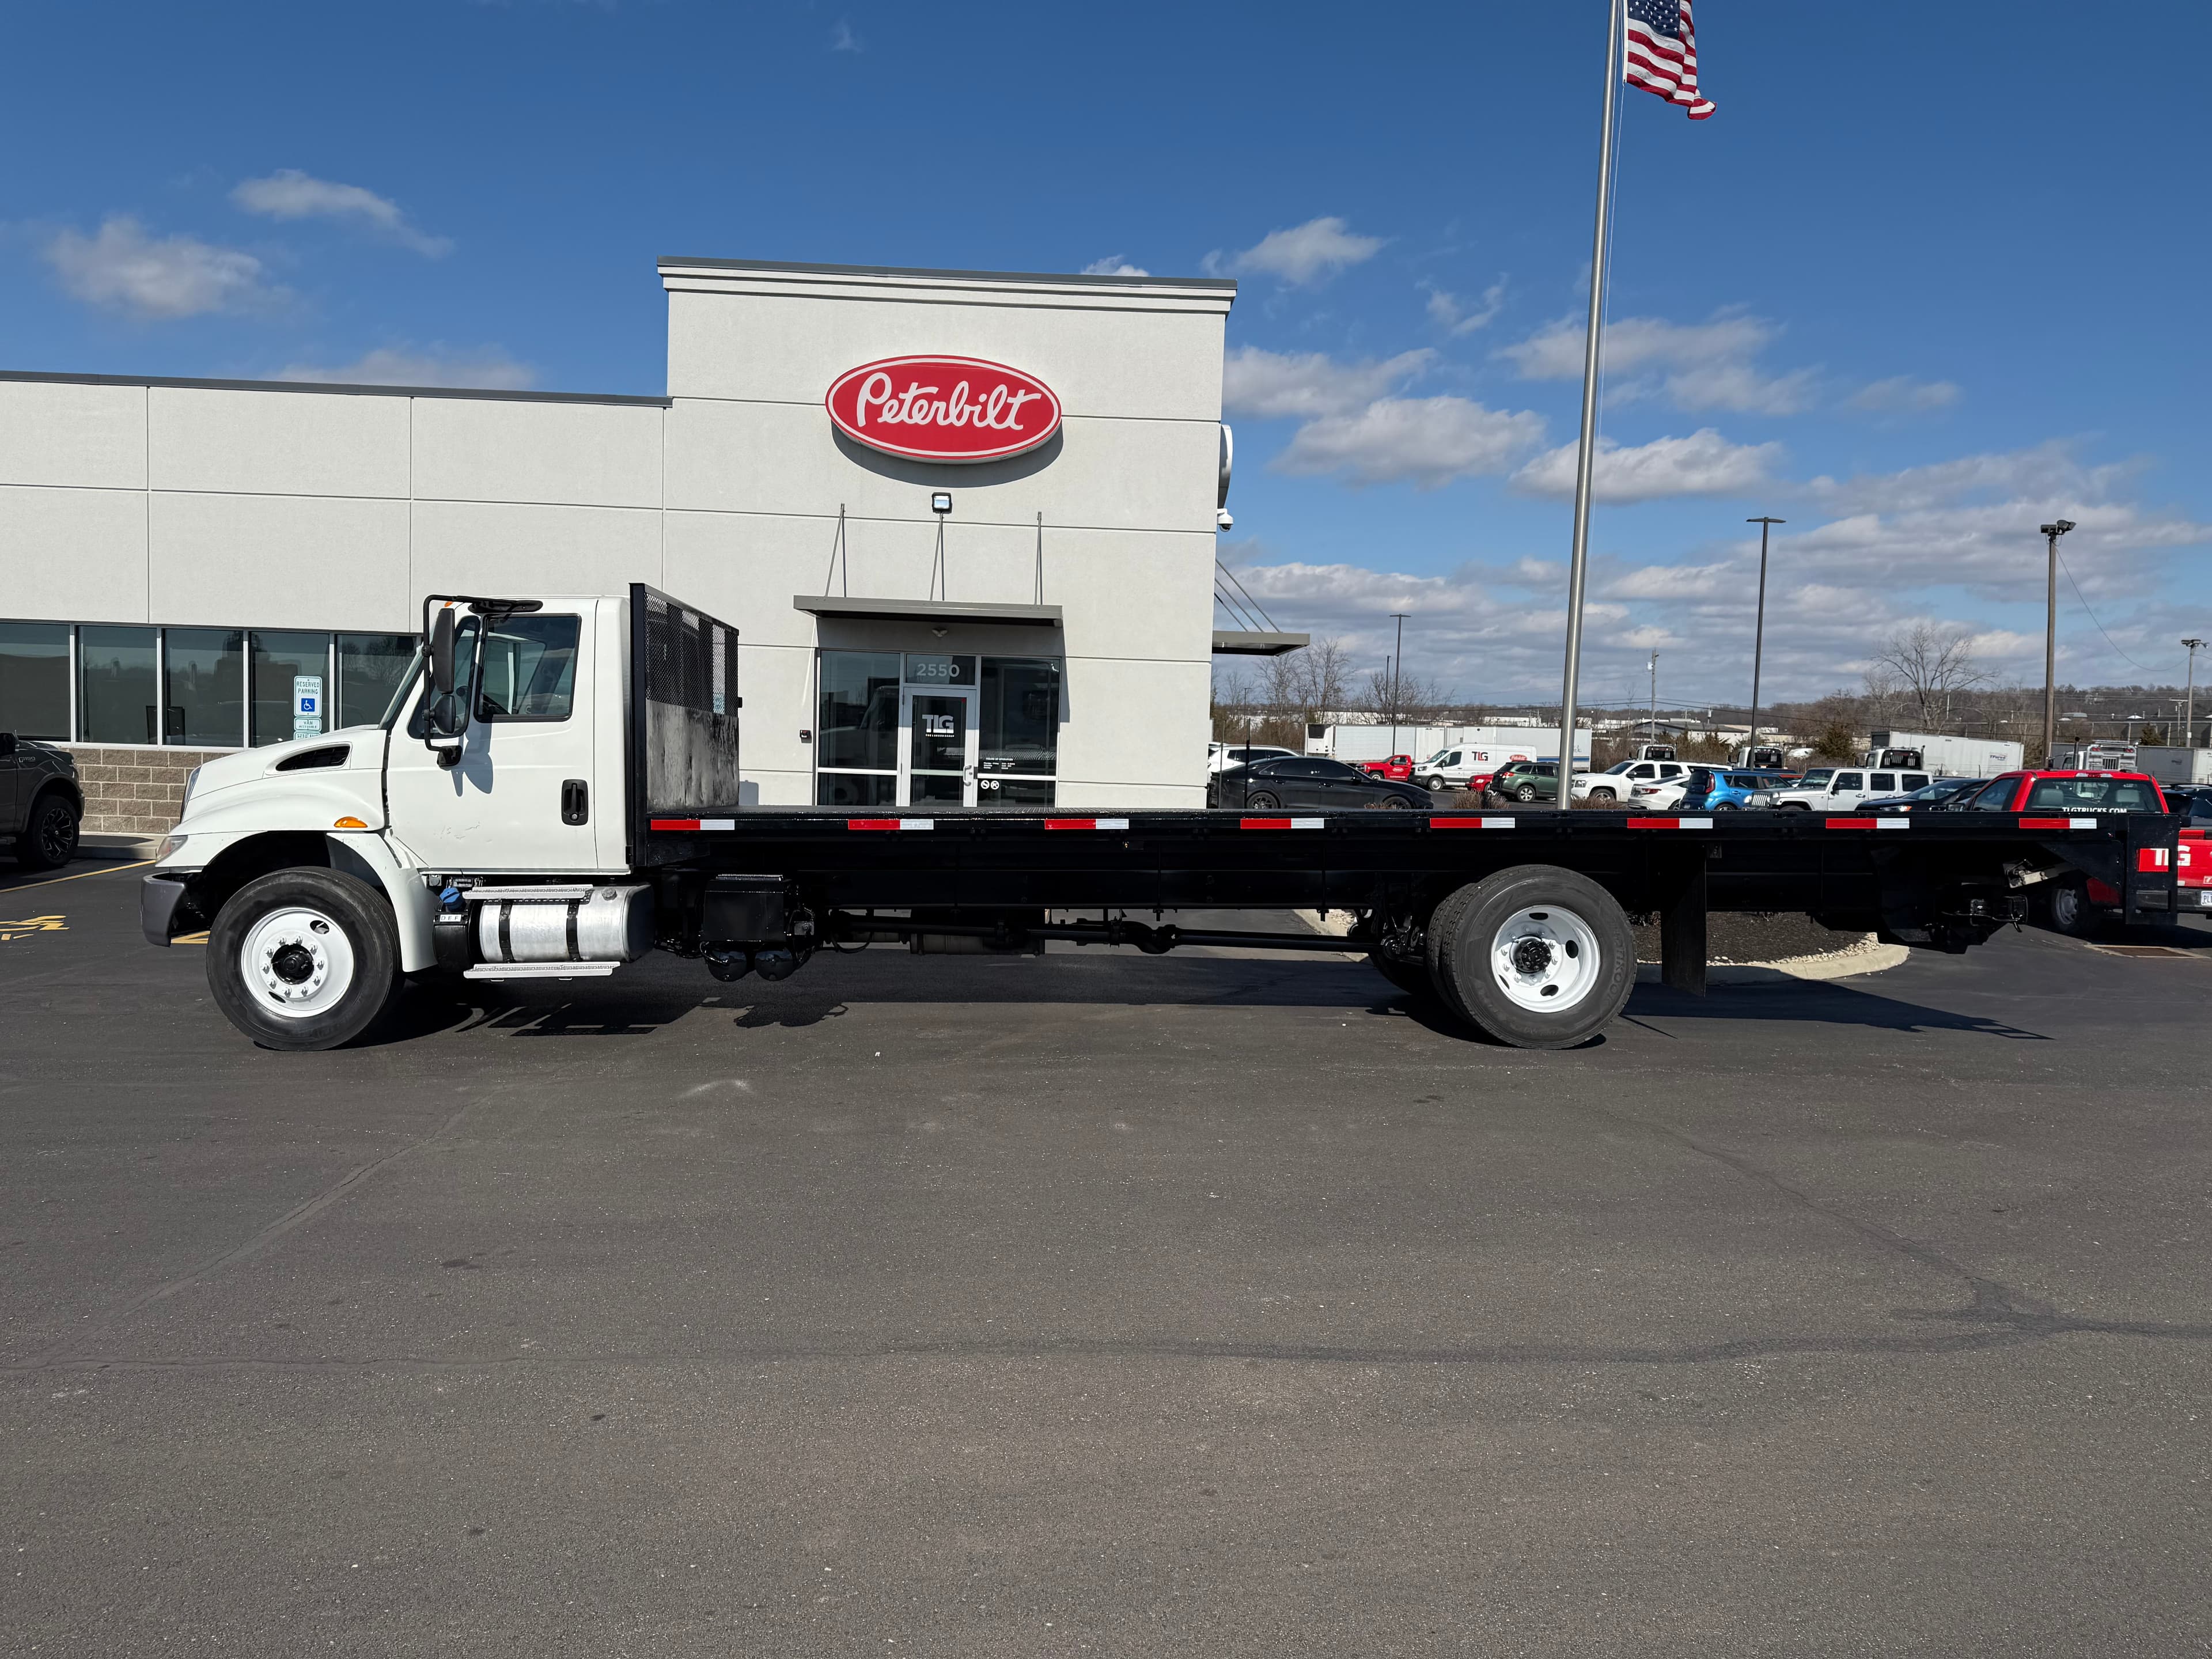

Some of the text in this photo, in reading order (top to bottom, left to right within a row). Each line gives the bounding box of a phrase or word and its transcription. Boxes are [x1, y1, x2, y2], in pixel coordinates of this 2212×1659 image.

[857, 372, 1041, 430] Peterbilt
[917, 664, 960, 677] 2550
[922, 714, 954, 733] TLG
[1472, 751, 1488, 761] TLG
